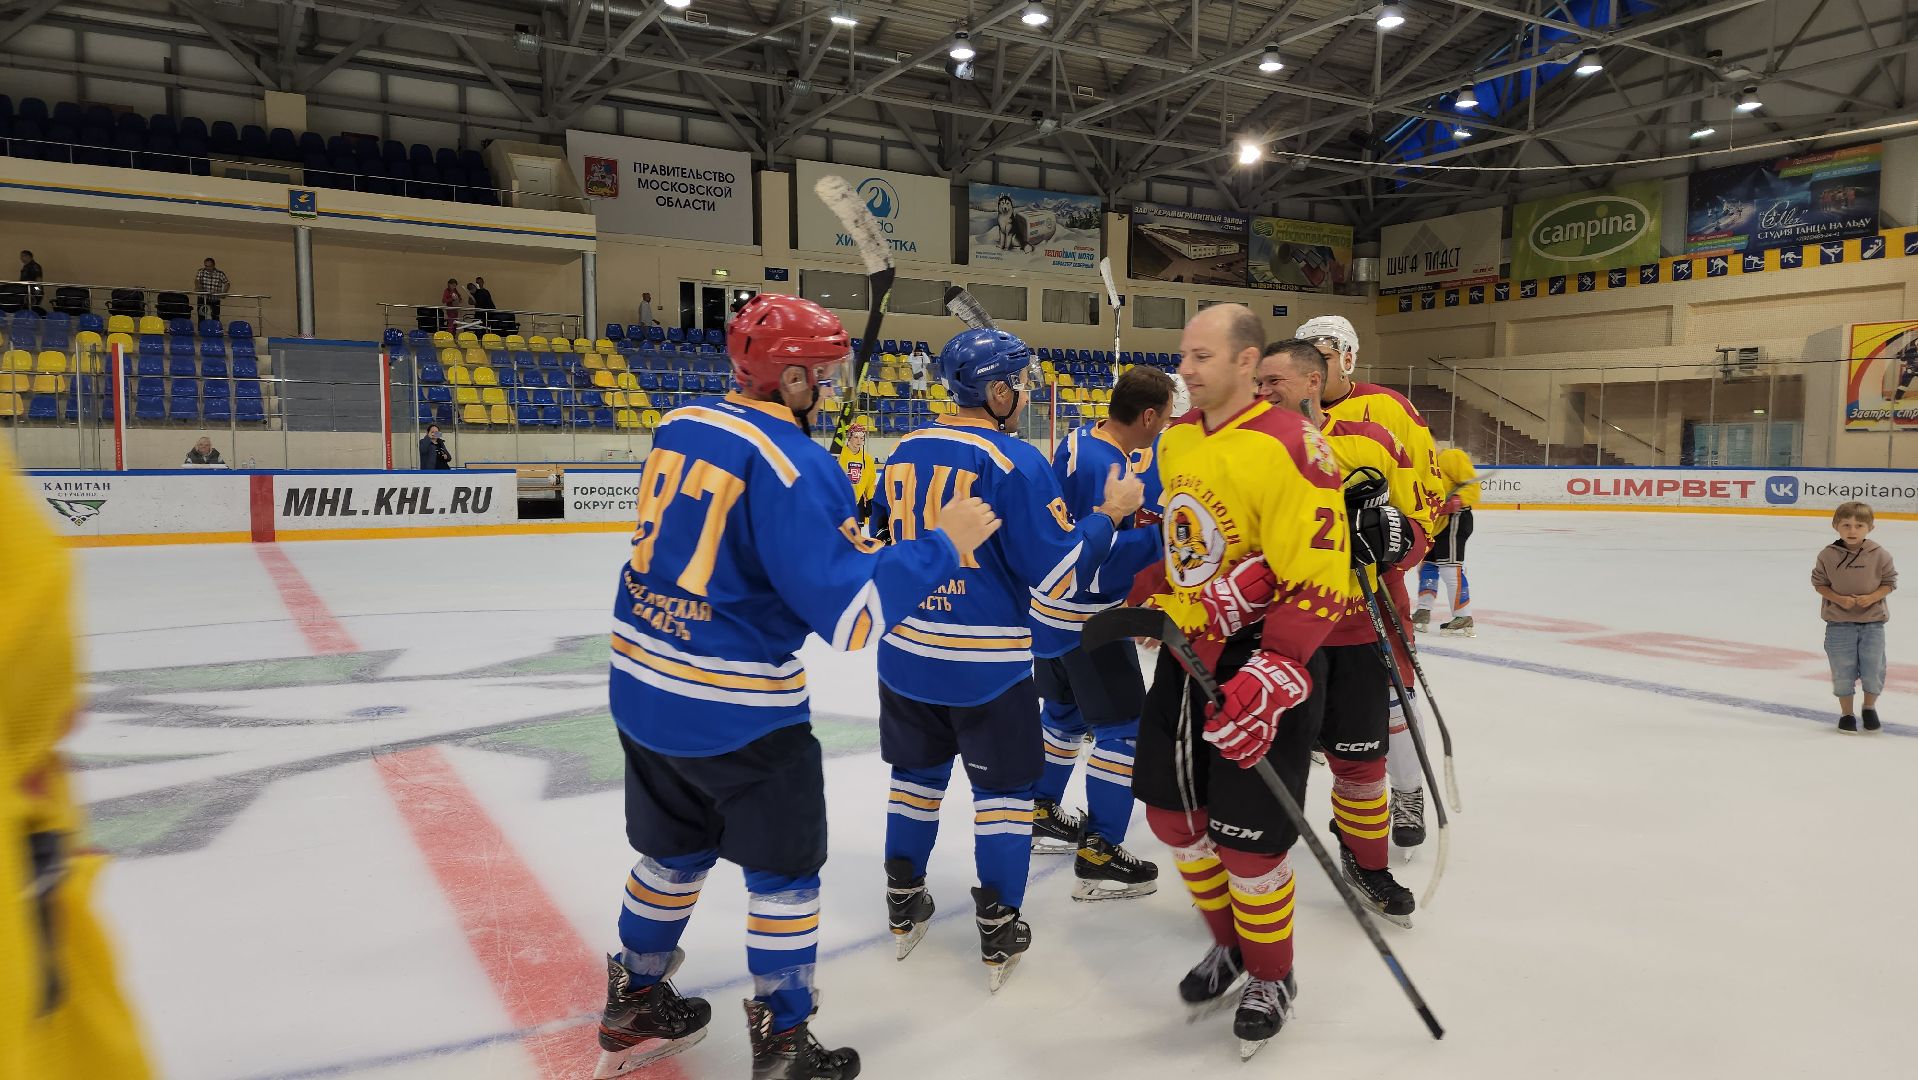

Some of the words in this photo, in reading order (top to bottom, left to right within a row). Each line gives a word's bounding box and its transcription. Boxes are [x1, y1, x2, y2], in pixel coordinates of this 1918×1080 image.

[633, 162, 735, 184] ПРАВИТЕЛЬСТВО
[637, 178, 732, 198] МОСКОВСКОЙ
[656, 196, 716, 212] ОБЛАСТИ
[1539, 213, 1637, 246] campina
[1757, 228, 1793, 240] СТУДИЯ
[1796, 223, 1827, 236] ТАНЦА
[1829, 222, 1844, 231] НА
[1845, 217, 1872, 229] ЛЬДУ
[1386, 253, 1418, 277] ШУГА
[1424, 247, 1462, 271] ПЛАСТ
[1849, 408, 1892, 420] Завтра
[43, 482, 111, 491] КАПИТАН
[573, 486, 640, 497] ГОРОДСКО
[1566, 478, 1757, 499] OLIMPBET
[1803, 482, 1918, 500] hckapitano
[282, 486, 494, 517] MHL.KHL.RU
[573, 501, 615, 510] ОКРУГ
[630, 448, 747, 597] 87
[1335, 739, 1380, 752] CCM
[1208, 817, 1265, 842] CCM
